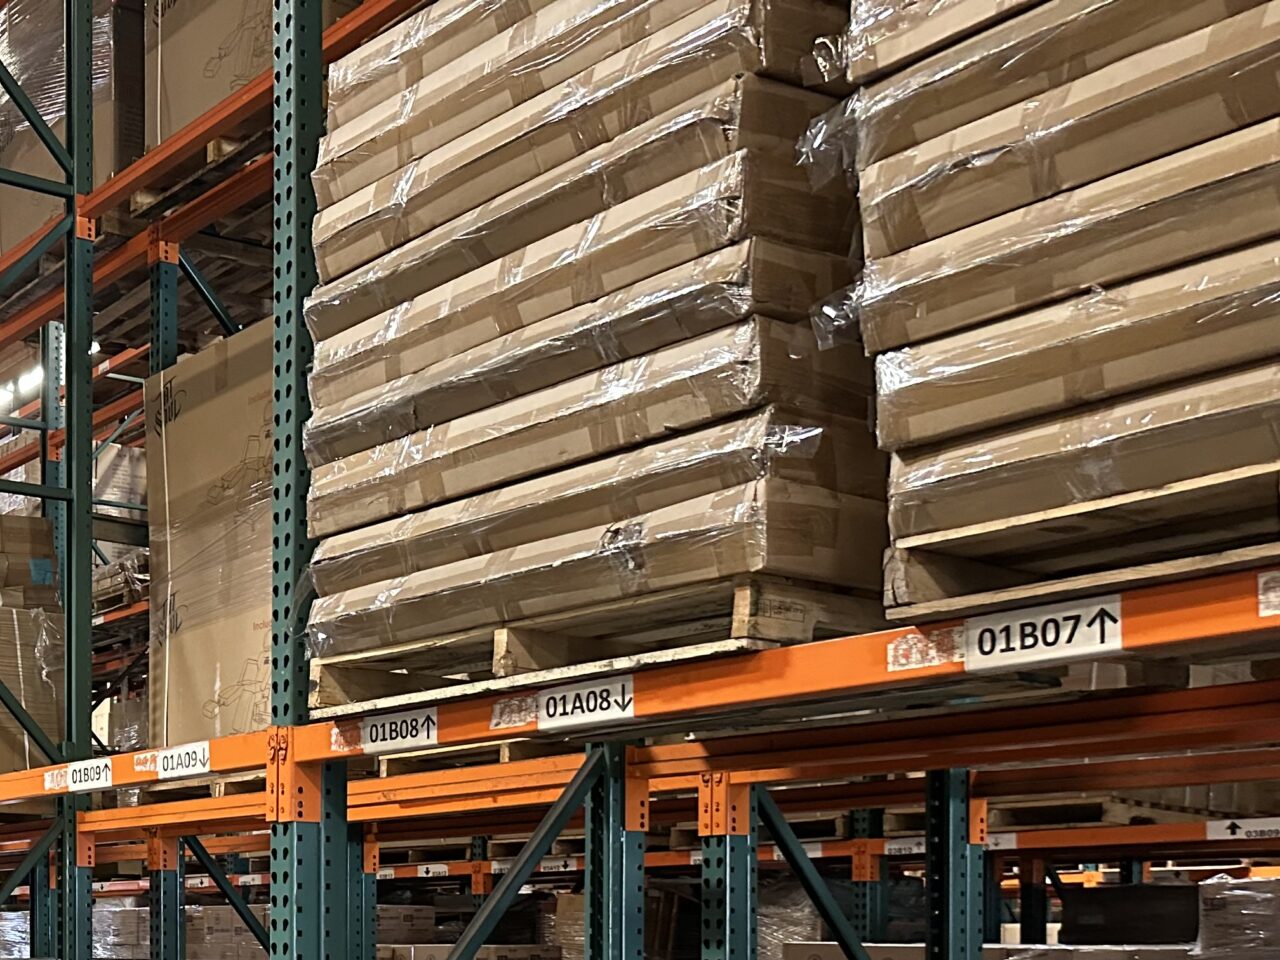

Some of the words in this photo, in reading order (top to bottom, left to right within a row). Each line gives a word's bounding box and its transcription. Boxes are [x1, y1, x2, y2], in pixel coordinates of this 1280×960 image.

[977, 615, 1083, 655] 01B07
[545, 688, 612, 719] 01A08
[369, 717, 420, 744] 01B08
[162, 753, 197, 771] 01A09
[71, 768, 101, 785] 01B09
